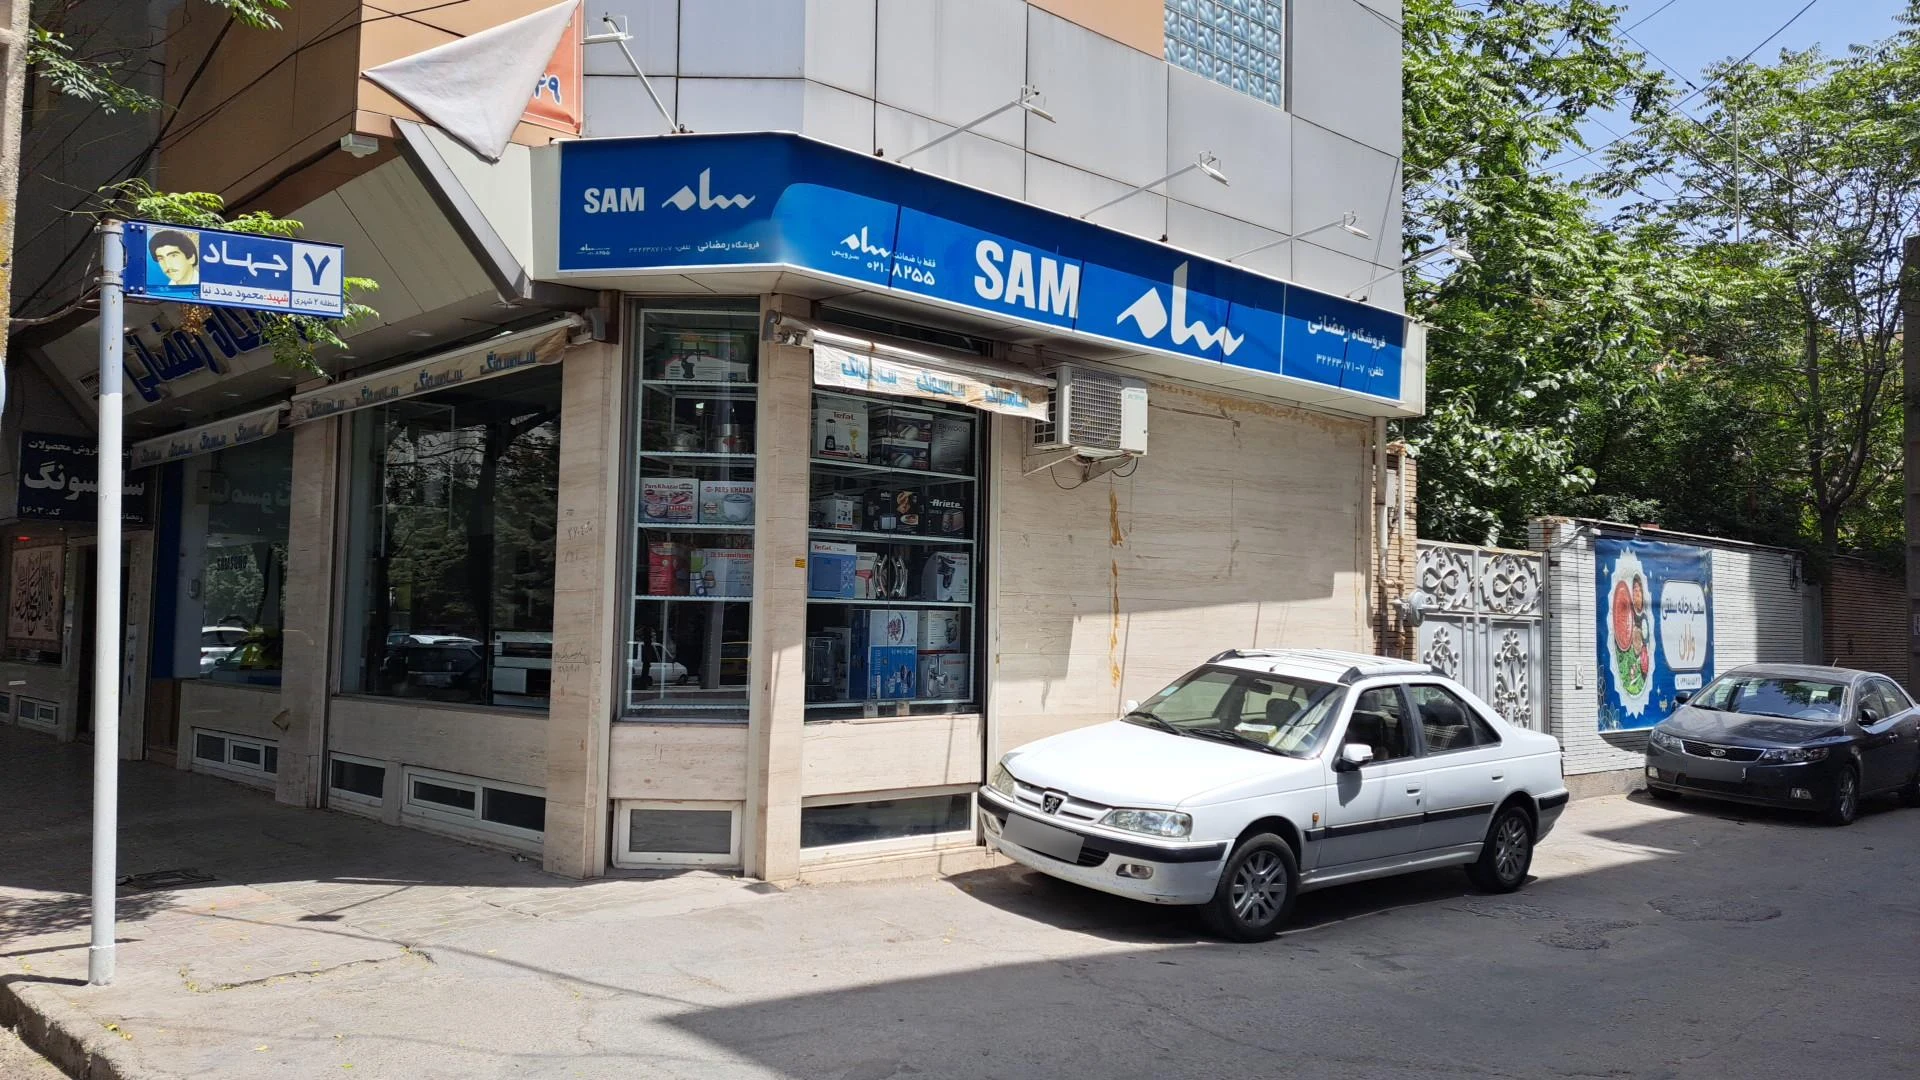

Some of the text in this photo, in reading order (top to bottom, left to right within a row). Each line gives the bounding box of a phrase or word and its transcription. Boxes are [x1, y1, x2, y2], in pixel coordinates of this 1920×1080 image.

[583, 187, 645, 214] SAM
[661, 167, 756, 212] سام
[697, 240, 760, 252] فروشگاه رمضانی
[840, 225, 891, 258] سام
[202, 240, 289, 278] جهاد
[303, 252, 331, 285] ۷
[923, 257, 936, 268] فقط
[974, 239, 1081, 319] SAM
[1116, 260, 1245, 356] سام
[1351, 328, 1387, 350] فروشگاه
[833, 411, 856, 421] Tefal
[930, 498, 964, 508] Ariete
